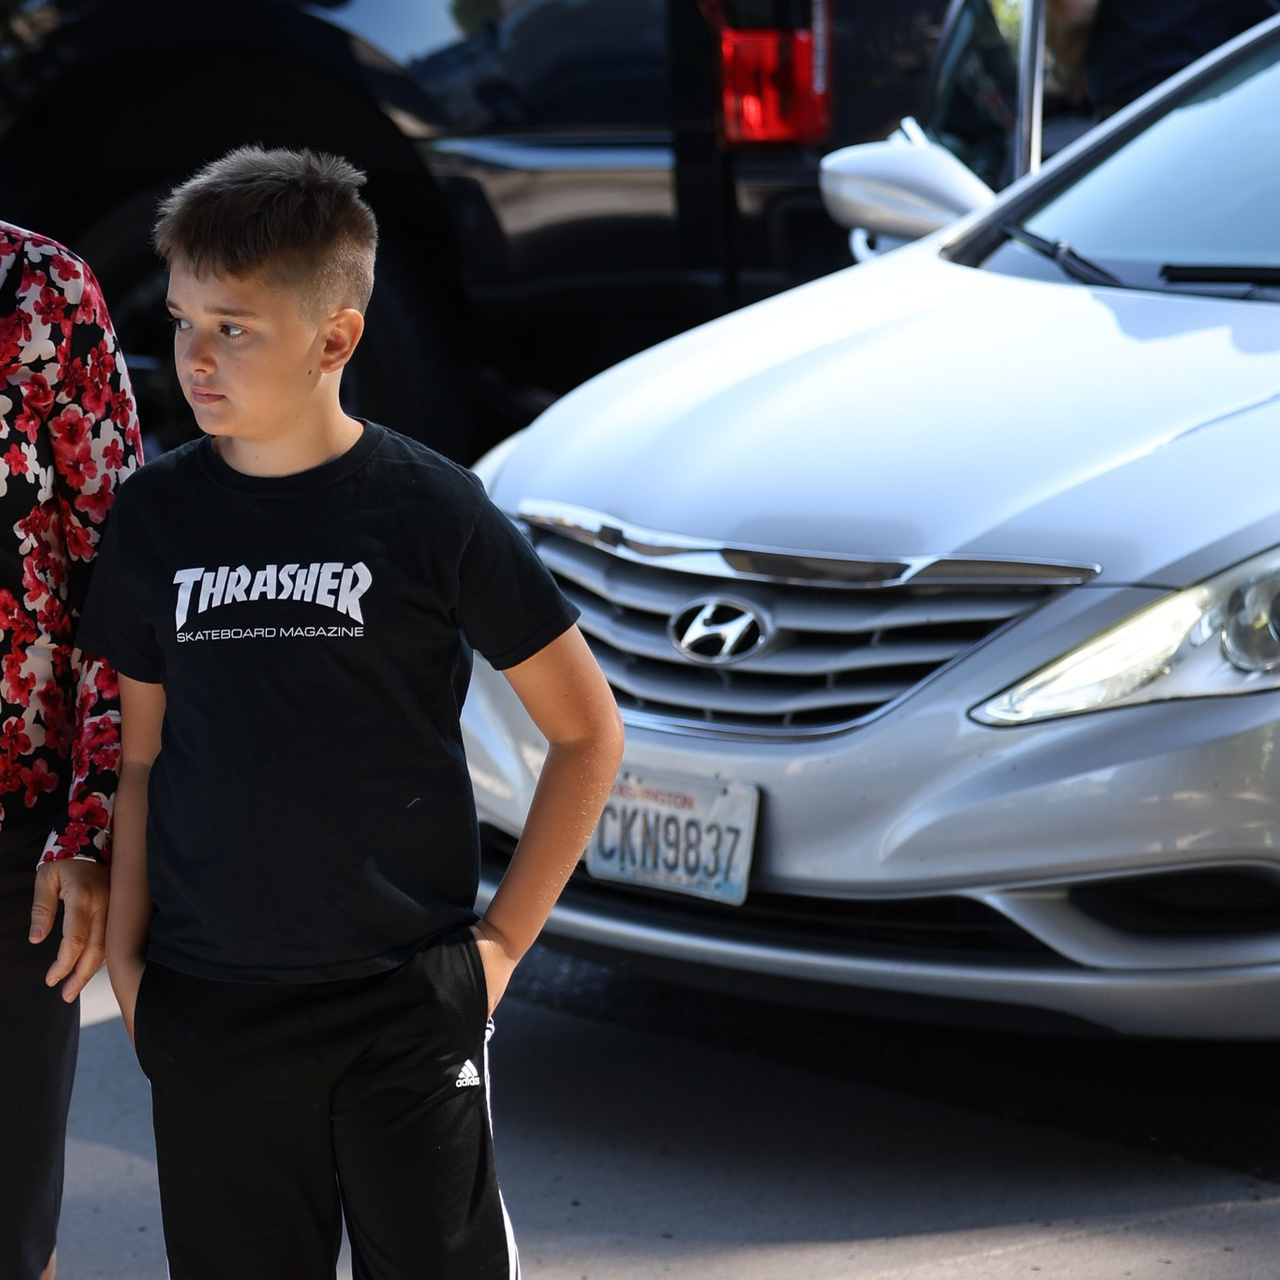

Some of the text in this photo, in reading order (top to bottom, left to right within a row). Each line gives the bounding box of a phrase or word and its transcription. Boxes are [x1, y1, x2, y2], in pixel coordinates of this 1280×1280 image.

[173, 561, 373, 632] THRASHER
[177, 626, 364, 643] SKATEBOARD MAGAZINE
[598, 804, 741, 884] CKN9837
